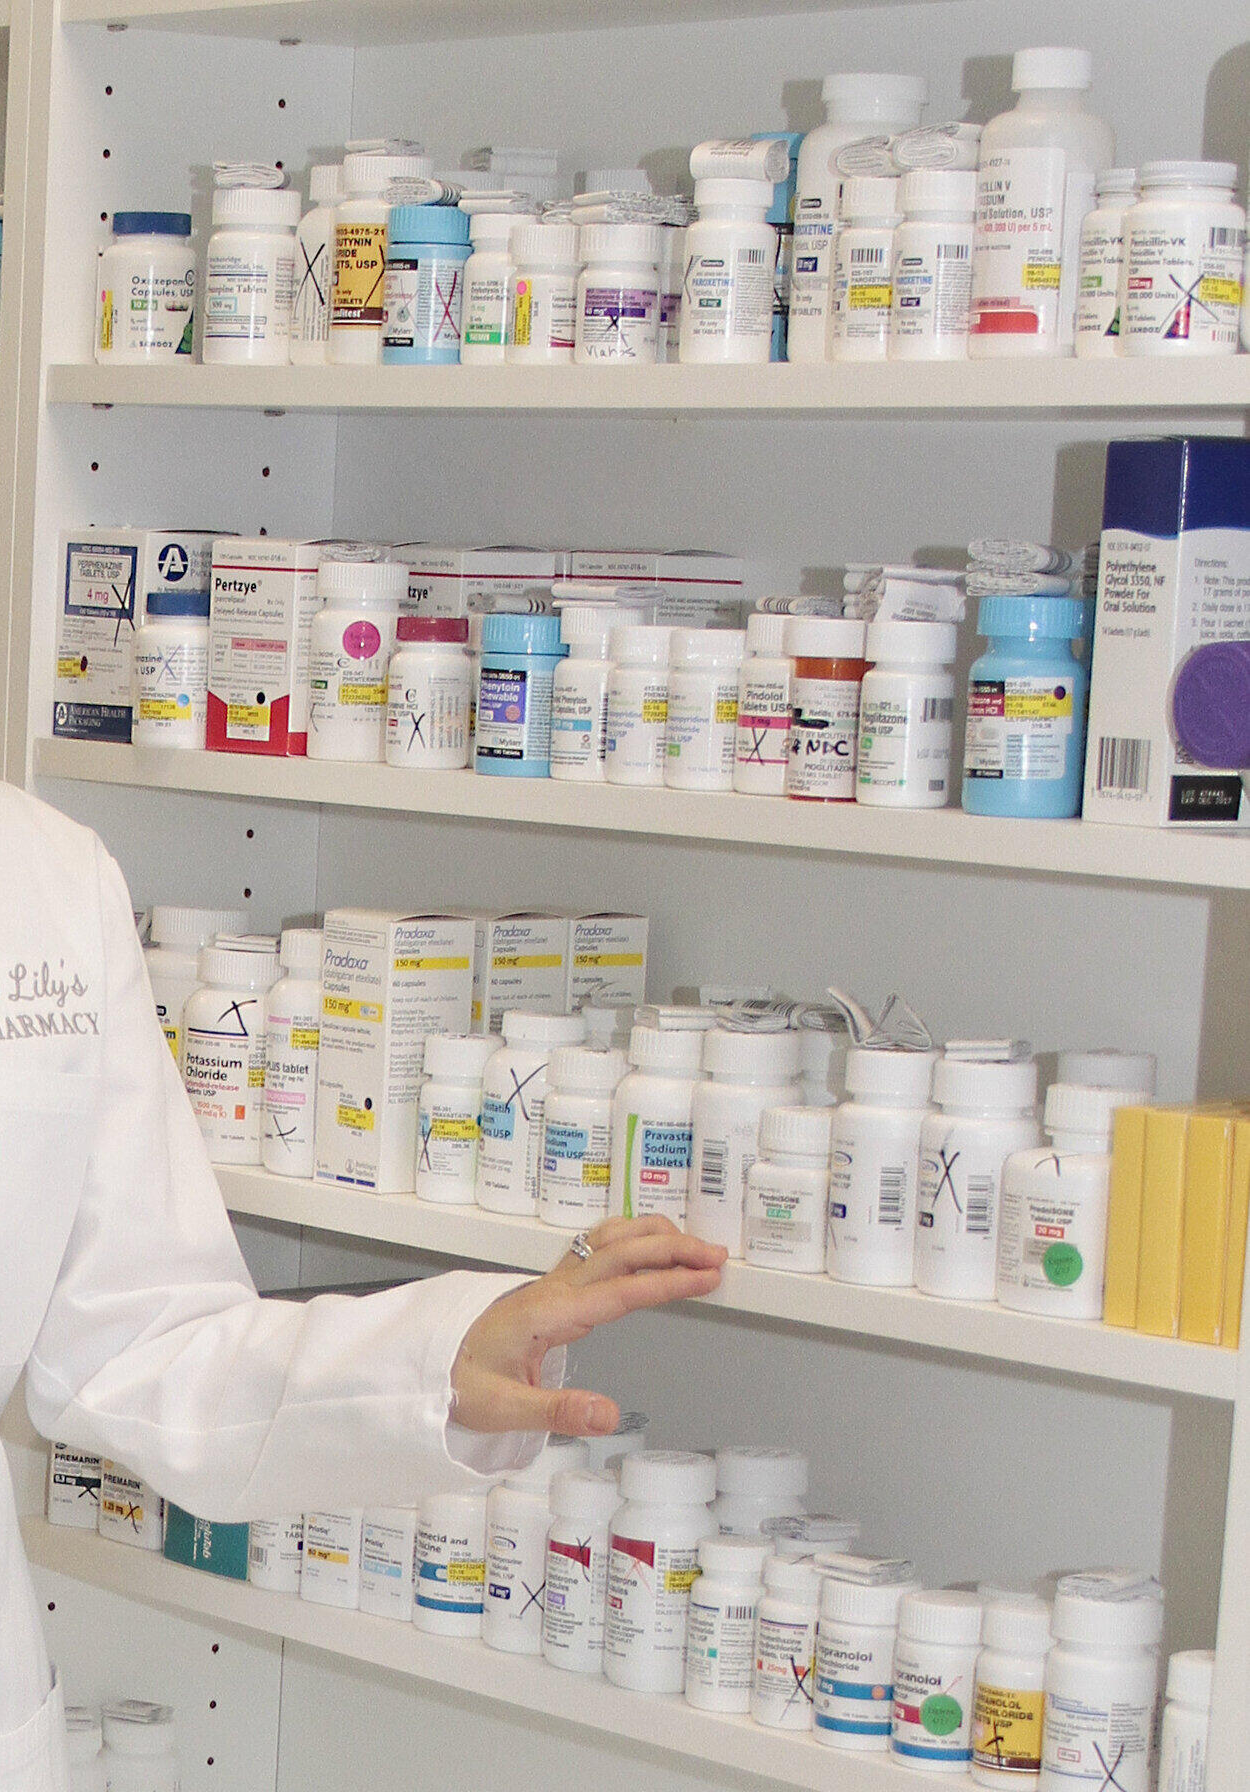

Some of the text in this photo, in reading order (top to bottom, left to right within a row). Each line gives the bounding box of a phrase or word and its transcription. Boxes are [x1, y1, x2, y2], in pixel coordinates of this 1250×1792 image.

[1106, 561, 1156, 574] Polyethylene
[215, 578, 257, 595] Pertzye
[1105, 575, 1128, 587] Glycol
[1131, 575, 1151, 586] 3350,
[94, 591, 109, 600] mg
[408, 585, 428, 601] tzye
[1104, 588, 1149, 599] Powder For
[1103, 601, 1156, 613] Oral Solution
[871, 778, 896, 786] accord
[324, 949, 368, 970] Pradaxa
[8, 958, 88, 1007] Lily's
[324, 999, 337, 1009] 150
[186, 1053, 242, 1069] Potassium
[186, 1066, 227, 1081] Chloride
[282, 1062, 309, 1074] tablet
[203, 1088, 216, 1096] USP
[493, 1129, 511, 1139] USP
[644, 1142, 687, 1154] Sodium
[644, 1156, 683, 1167] Tablets
[55, 1453, 100, 1464] PREMARIN
[104, 1473, 141, 1489] PREMARIN
